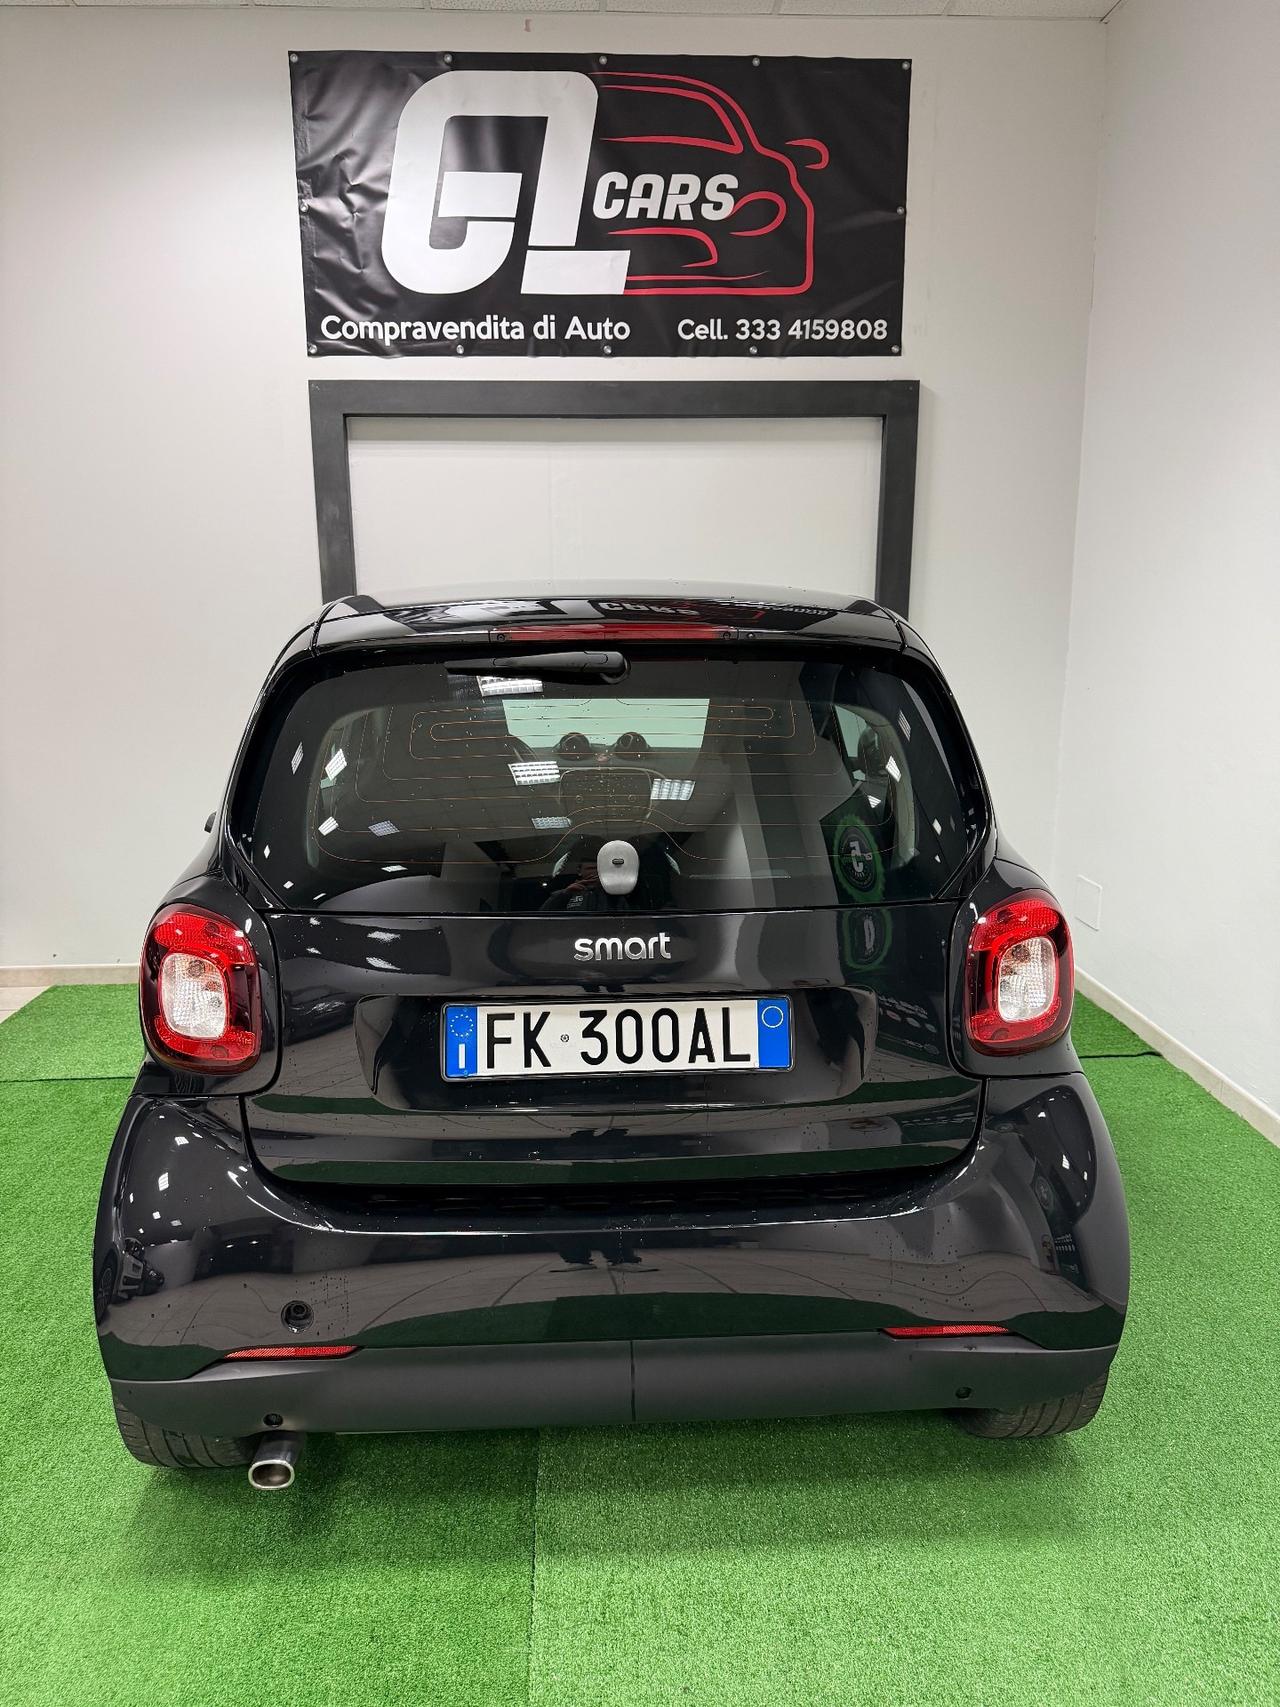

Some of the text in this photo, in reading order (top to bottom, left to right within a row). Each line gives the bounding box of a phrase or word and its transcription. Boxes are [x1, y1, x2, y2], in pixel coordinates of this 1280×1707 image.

[592, 171, 739, 221] CARS
[320, 314, 631, 346] Compravendita di Auto
[677, 318, 889, 341] Cell. 333 4159808
[574, 932, 672, 962] smart
[486, 1006, 751, 1069] FK 300AL
